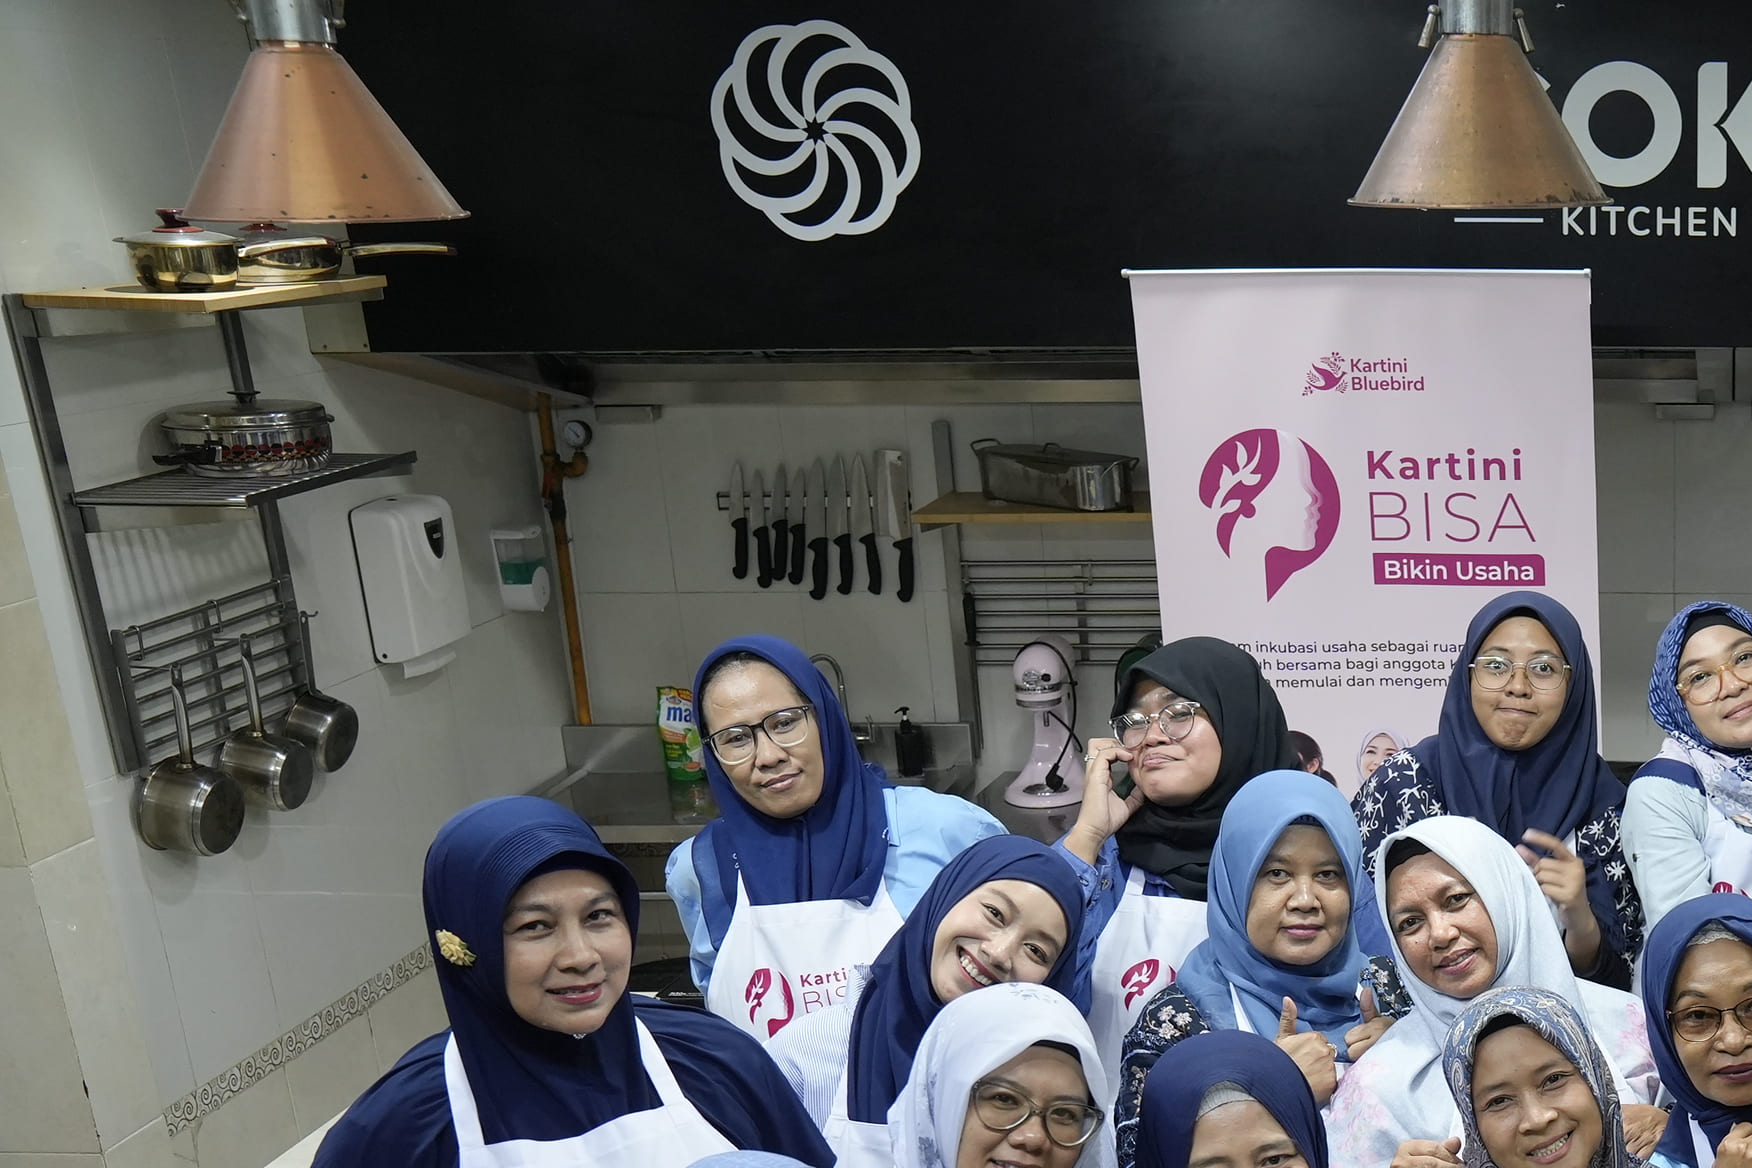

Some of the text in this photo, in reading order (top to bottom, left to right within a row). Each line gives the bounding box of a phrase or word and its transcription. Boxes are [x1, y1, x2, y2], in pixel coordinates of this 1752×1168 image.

[1562, 206, 1737, 237] KITCHEN
[1350, 357, 1408, 373] Kartini
[1351, 376, 1425, 391] Bluebird
[1367, 448, 1521, 480] Kartini
[1369, 491, 1536, 543] BISA
[1384, 559, 1535, 581] Bikin Usaha
[1256, 641, 1317, 653] inkubasi
[1322, 640, 1367, 653] usaha
[1371, 640, 1429, 655] sebagai
[1276, 658, 1341, 671] bersama
[1346, 657, 1379, 672] bagi
[1383, 659, 1445, 672] anggota
[1276, 675, 1451, 690] memulai dan mengem
[666, 706, 692, 722] ma
[800, 967, 848, 987] Karti
